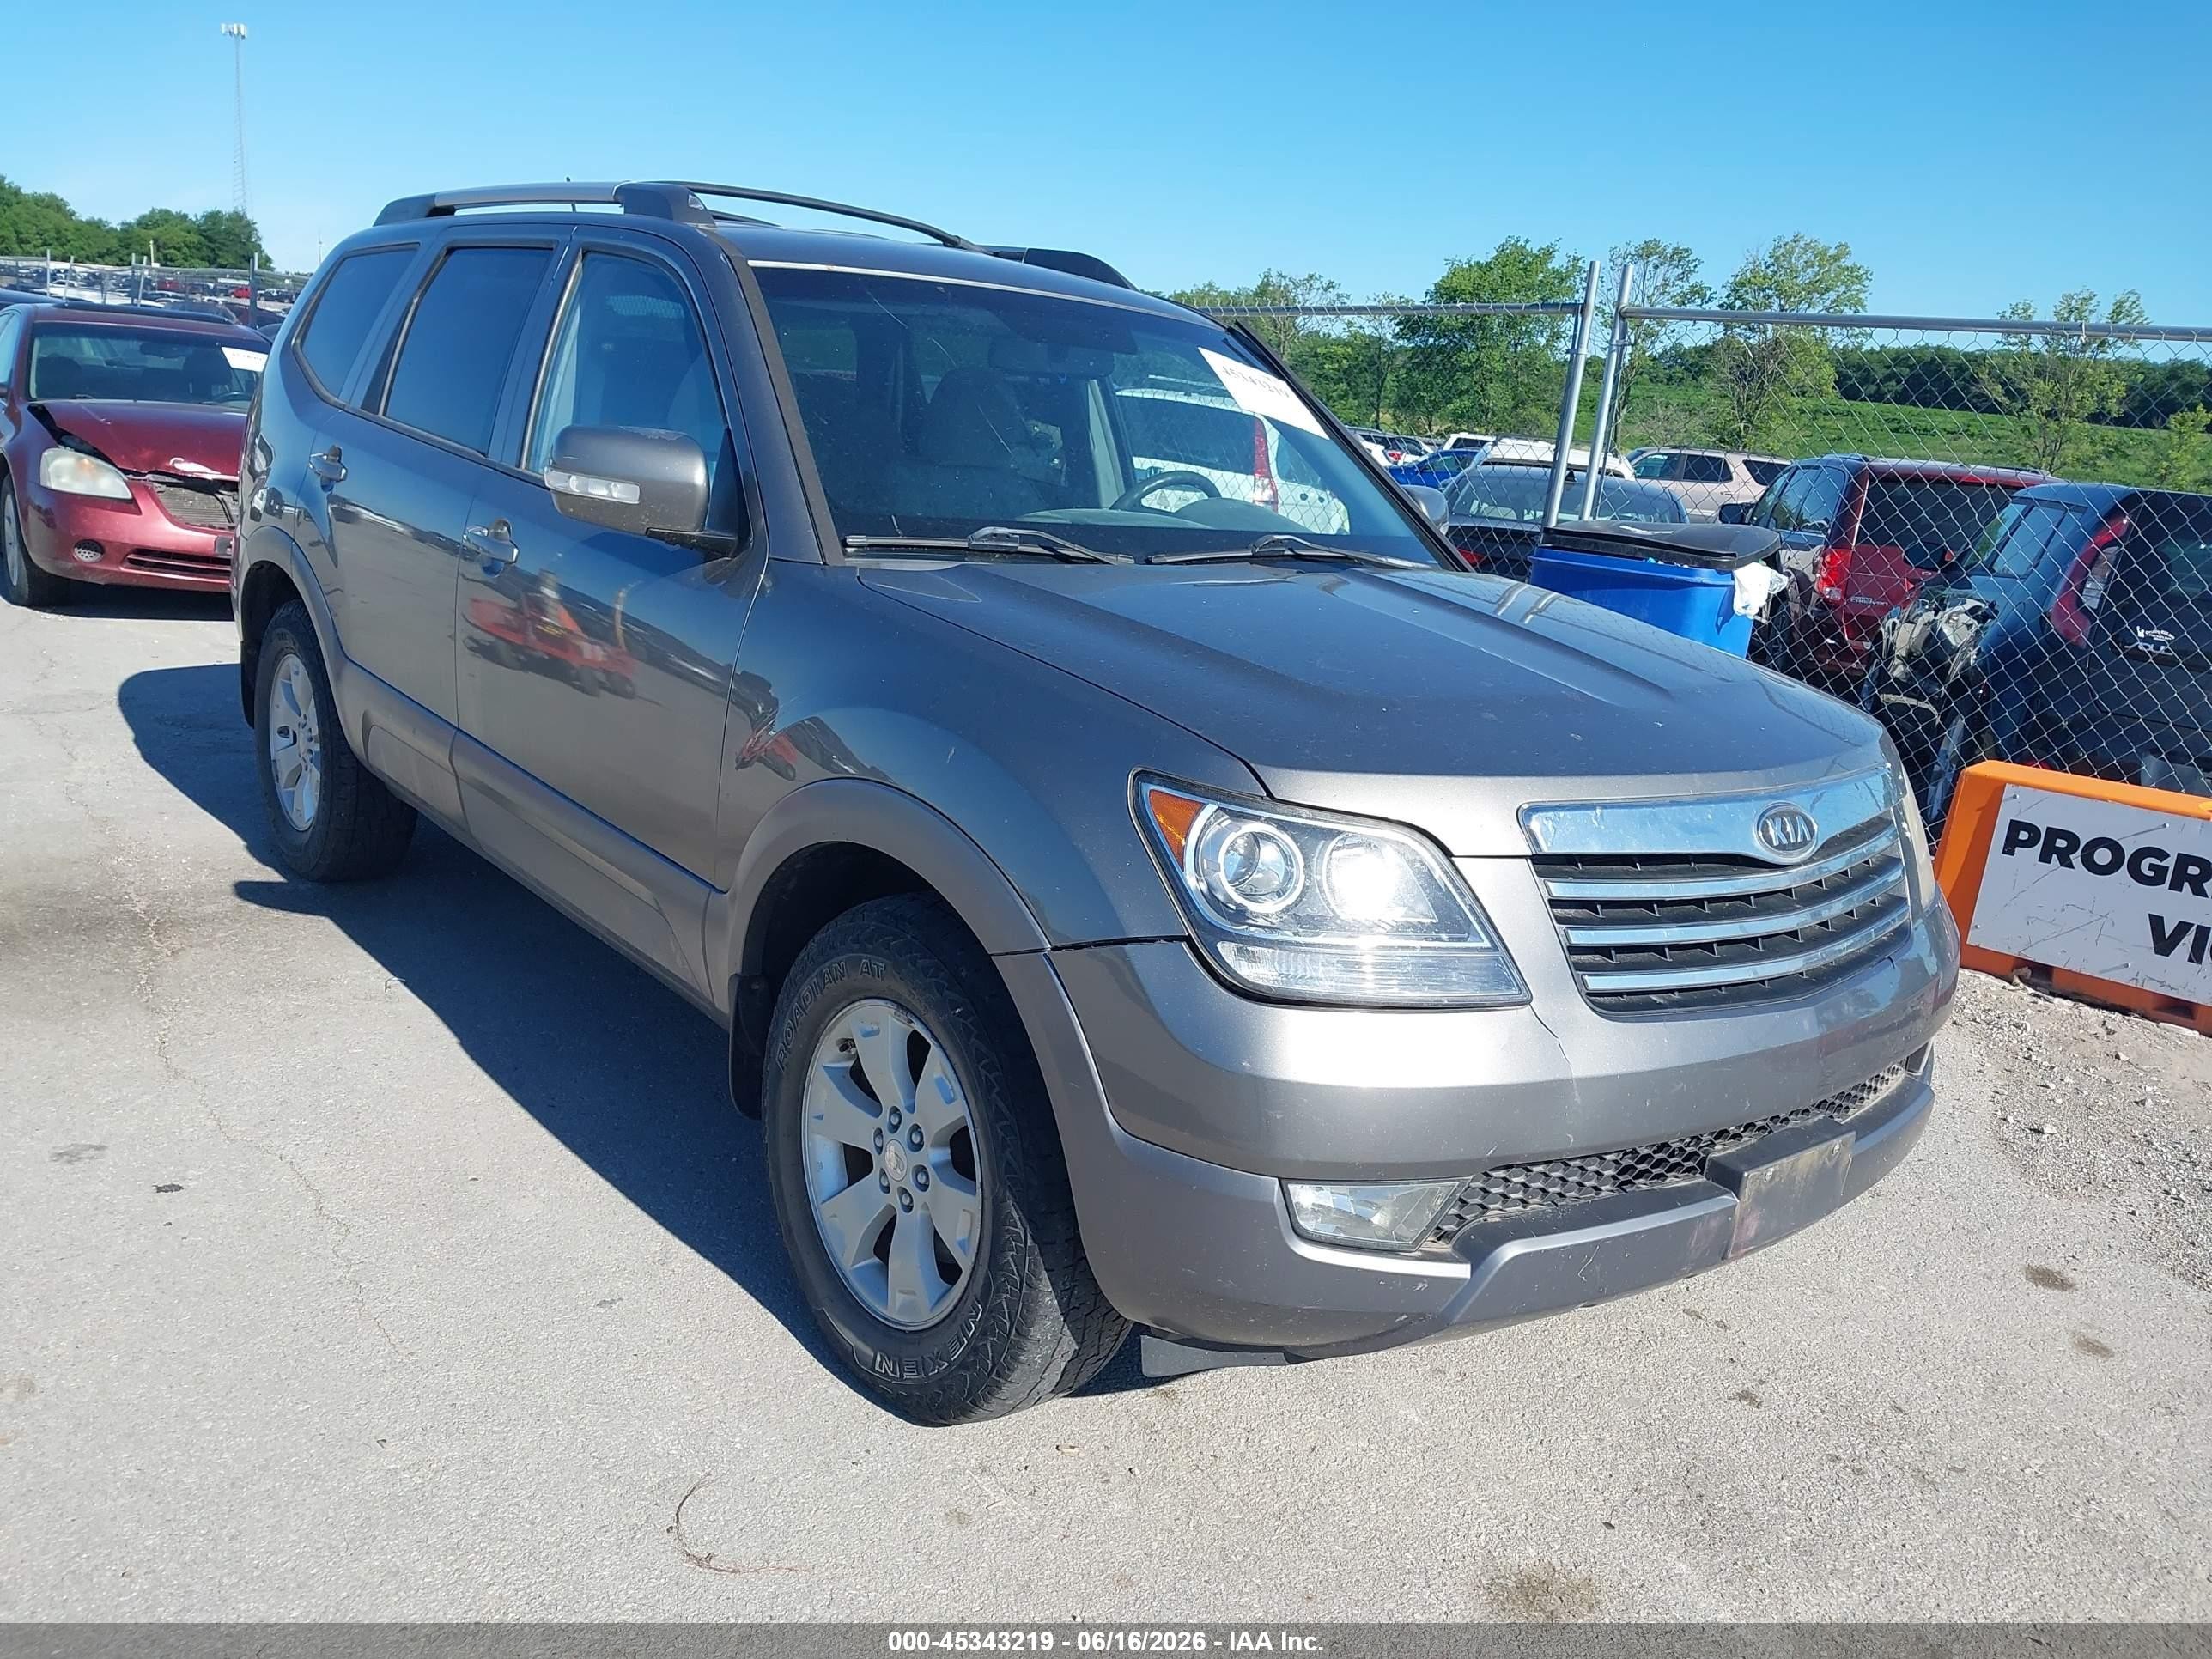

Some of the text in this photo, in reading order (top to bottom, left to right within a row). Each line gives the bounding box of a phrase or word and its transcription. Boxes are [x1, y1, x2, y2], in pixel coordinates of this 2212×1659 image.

[1765, 815, 1812, 847] KIA
[2148, 913, 2212, 965] VI
[776, 958, 885, 1073] ROADIAN AT
[874, 1296, 983, 1380] NEXEN
